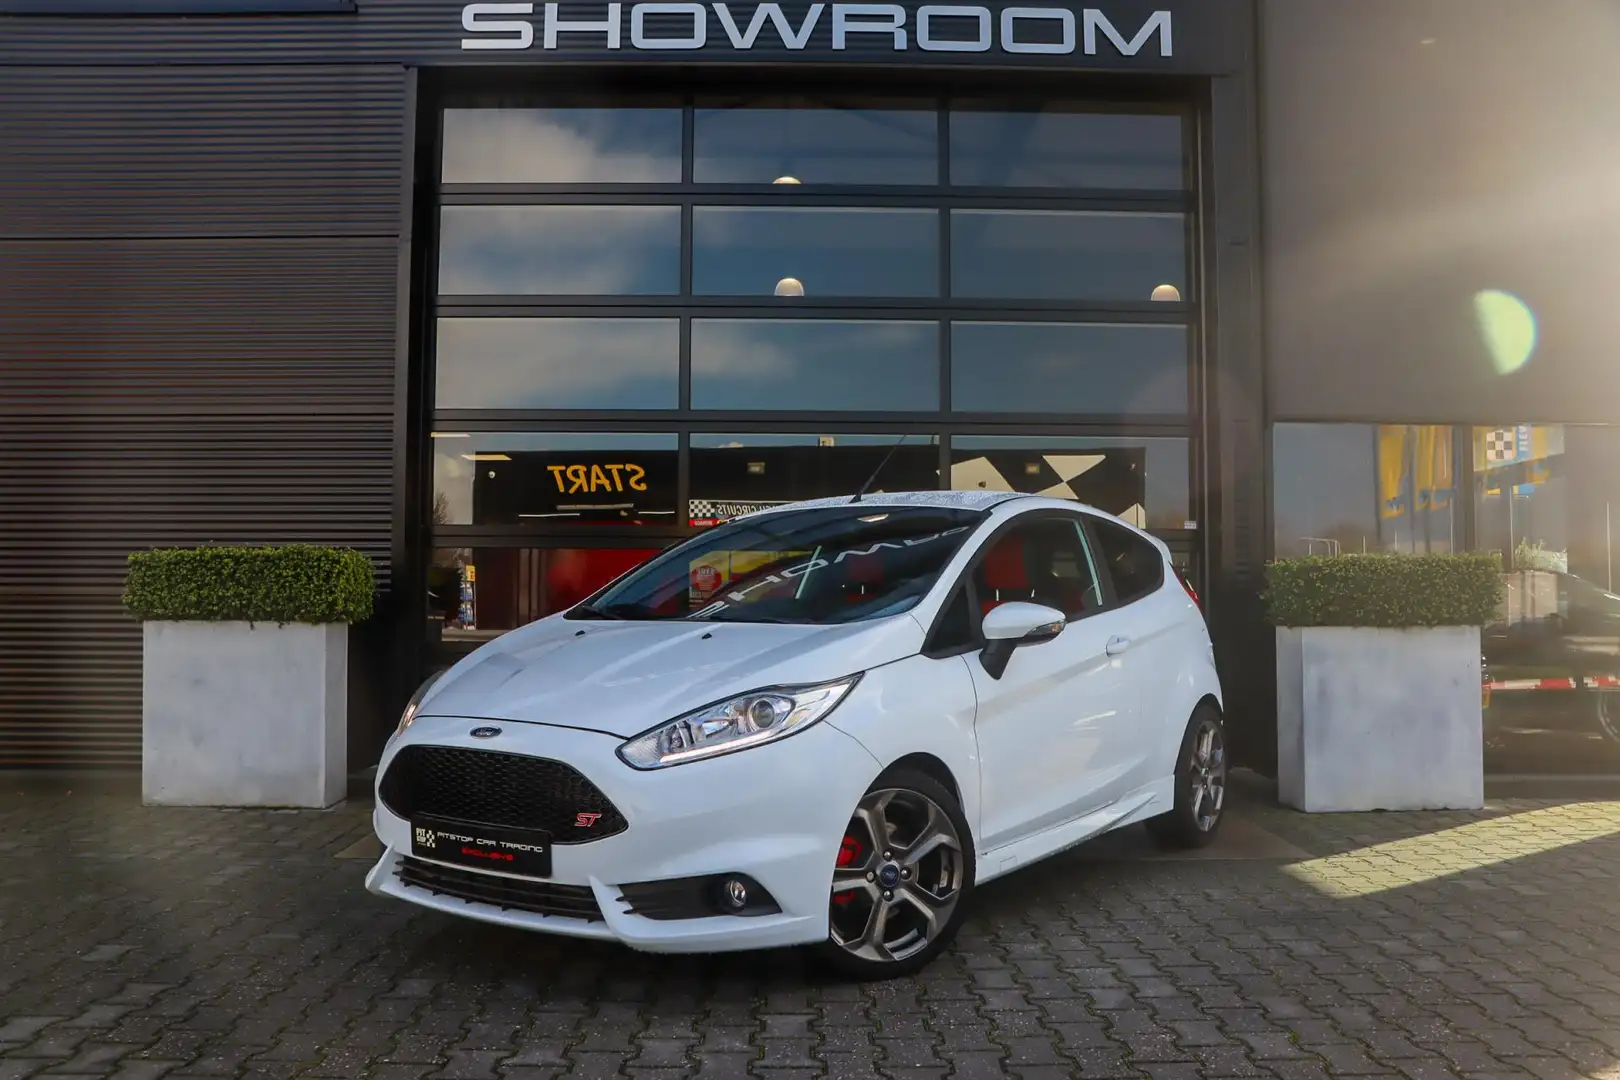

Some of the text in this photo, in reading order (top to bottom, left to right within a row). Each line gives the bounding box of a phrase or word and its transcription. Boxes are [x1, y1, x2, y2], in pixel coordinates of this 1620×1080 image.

[461, 3, 1172, 57] SHOWROOM
[575, 813, 601, 827] ST
[437, 831, 543, 853] PITSTOP CAR TRADING
